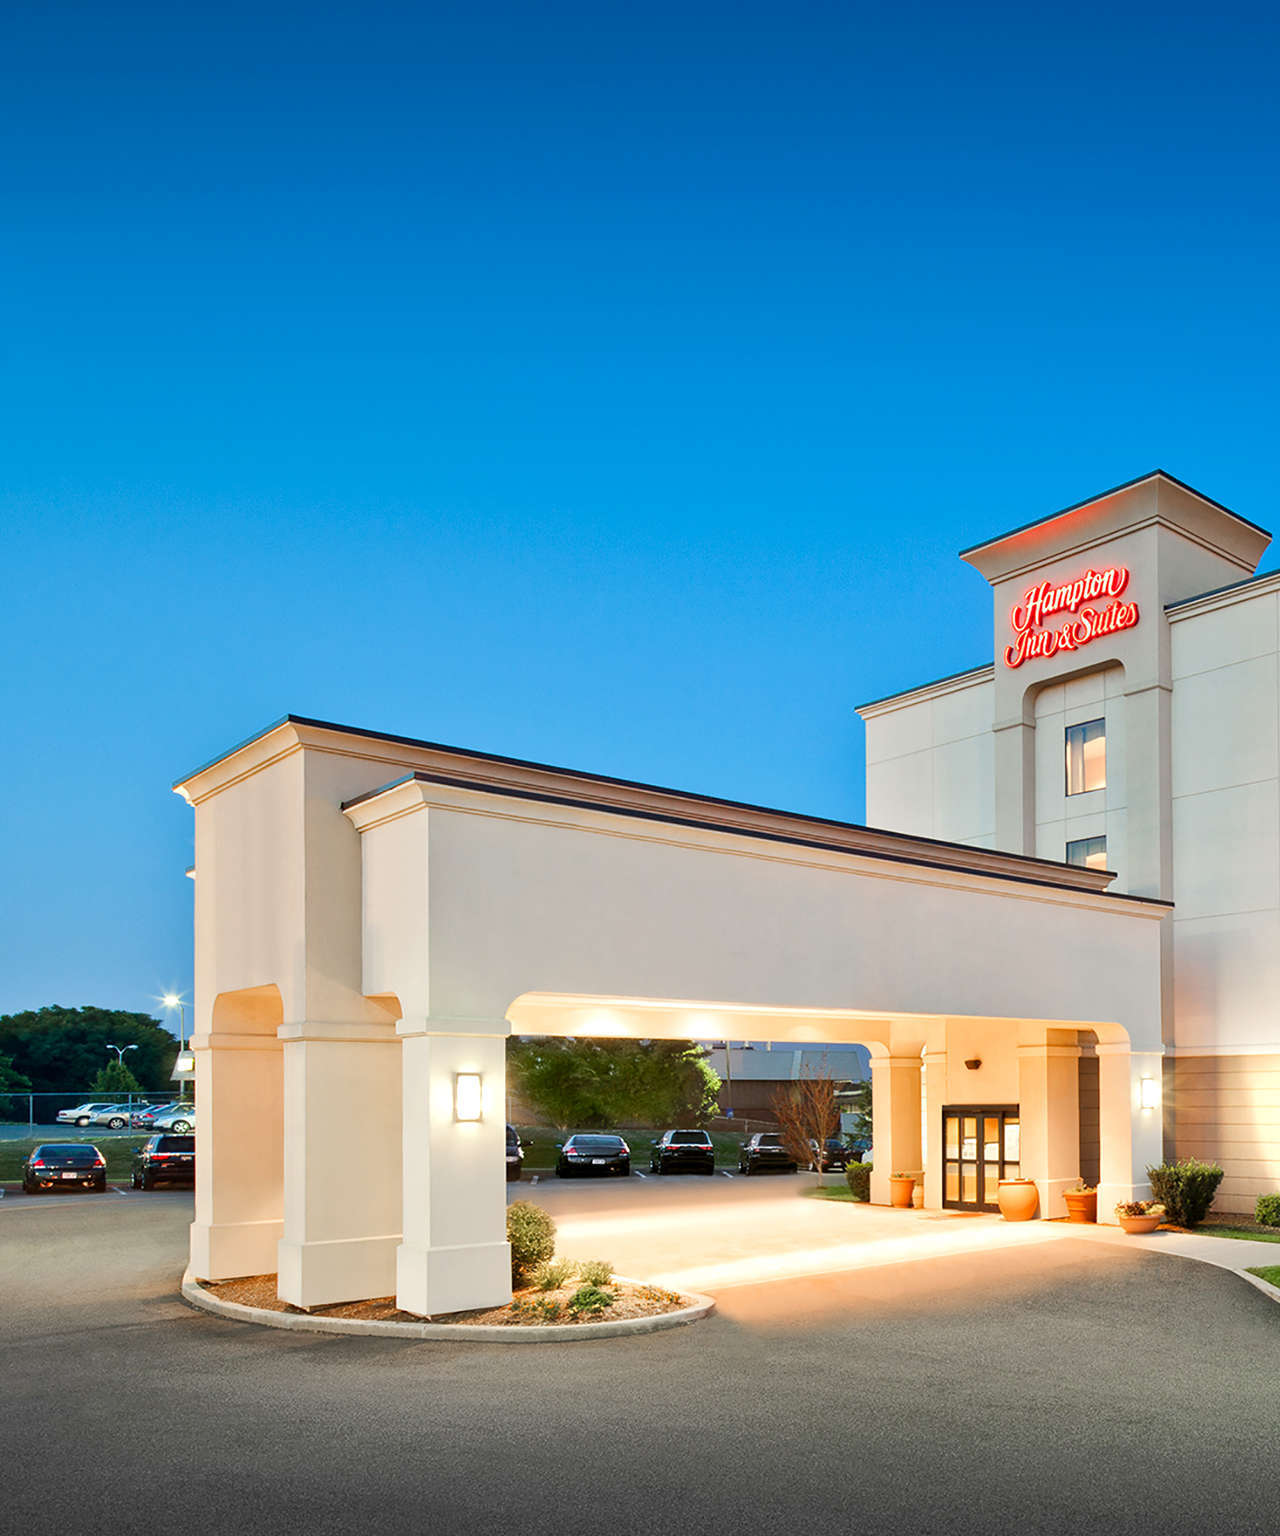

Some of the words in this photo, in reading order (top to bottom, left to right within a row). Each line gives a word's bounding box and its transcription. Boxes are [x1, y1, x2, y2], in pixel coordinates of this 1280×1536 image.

[1012, 568, 1129, 632] Hampton
[1004, 628, 1059, 668] Inn
[1058, 623, 1077, 650] &
[1072, 600, 1139, 645] Suites
